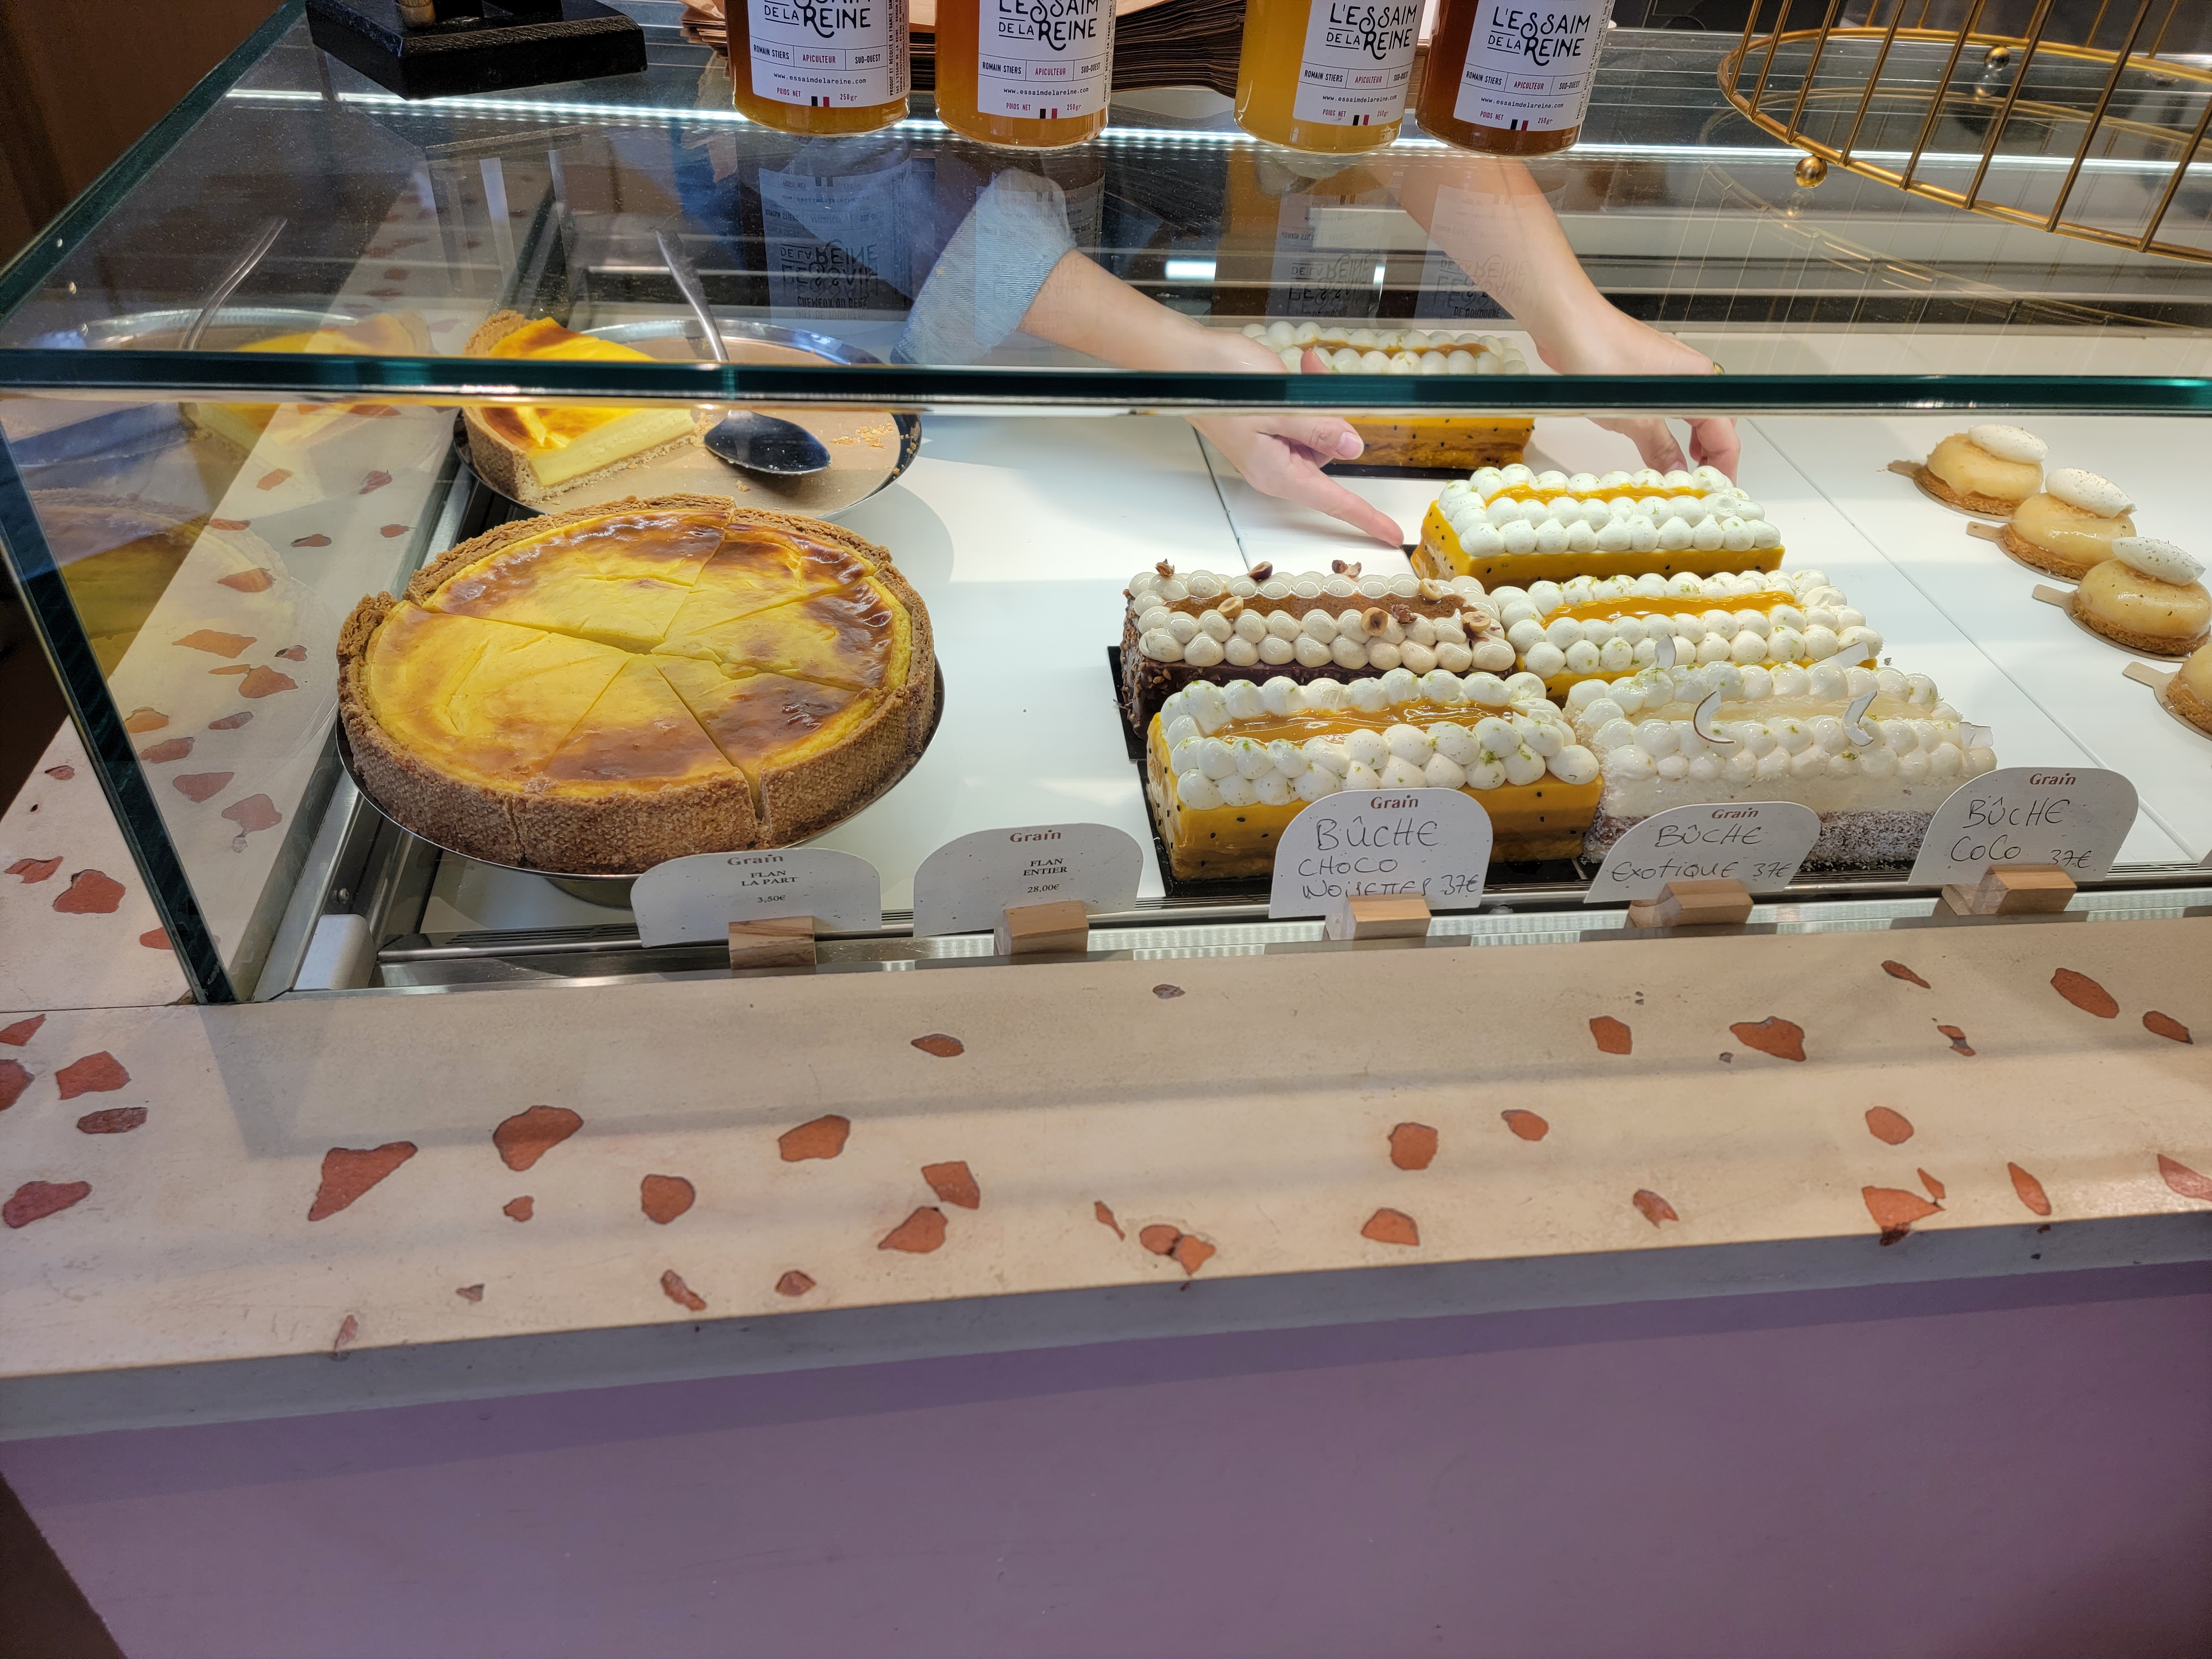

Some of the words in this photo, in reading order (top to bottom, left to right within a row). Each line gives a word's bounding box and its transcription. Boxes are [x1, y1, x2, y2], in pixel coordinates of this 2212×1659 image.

[764, 5, 779, 18] DE
[784, 8, 799, 21] LA
[803, 7, 871, 38] REINE
[1329, 3, 1417, 34] L'ESSAIM
[1493, 6, 1591, 39] L'ESSAIM
[998, 22, 1014, 33] DE
[1019, 24, 1034, 35] LA
[1038, 18, 1098, 51] REINE
[1326, 32, 1343, 43] DE
[1345, 34, 1360, 45] LA
[1363, 28, 1413, 60] REINE
[1488, 35, 1504, 47] DE
[1507, 38, 1521, 50] LA
[1524, 37, 1585, 66] REINE
[753, 44, 770, 56] ROMAIN
[772, 50, 789, 60] STIERS
[802, 54, 836, 64] APICULTEUR
[855, 54, 881, 64] SUD-OUEST
[982, 62, 1001, 72] ROMAIN
[1003, 65, 1021, 75] STIERS
[1081, 62, 1101, 74] SUD-OUEST
[774, 72, 867, 84] www.essaimdelareine.com
[1304, 70, 1323, 80] ROMAIN
[1325, 74, 1343, 82] STIERS
[1465, 71, 1483, 82] ROMAIN
[1484, 76, 1503, 86] STIERS
[1004, 87, 1089, 96] www.essaimdelareine.com
[1514, 81, 1544, 90] APICULTEUR
[1559, 81, 1580, 90] SUD-OUEST
[777, 87, 790, 96] POIDS
[840, 93, 858, 102] 250gr
[1322, 95, 1397, 103] www.essaimdelareine.com
[1481, 97, 1564, 108] www.essaimdelareine.com
[1480, 111, 1493, 119] POIDS
[2030, 773, 2077, 786] Grain
[1370, 794, 1419, 809] Grain
[1712, 807, 1760, 820] Grain
[1962, 796, 2070, 828] BÛCHE
[1010, 829, 1062, 843] Grain
[1316, 816, 1439, 851] BÛCHE
[1654, 823, 1763, 848] BÛCHE
[727, 853, 784, 865] Grain
[1030, 858, 1063, 867] FLAN
[2049, 849, 2093, 869] 37€
[750, 870, 786, 878] FLAN
[1022, 866, 1068, 876] ENTIER
[1752, 861, 1793, 878] 37€
[763, 877, 798, 885] PART
[1441, 874, 1479, 895] 37€
[1027, 883, 1060, 893] 28,00€
